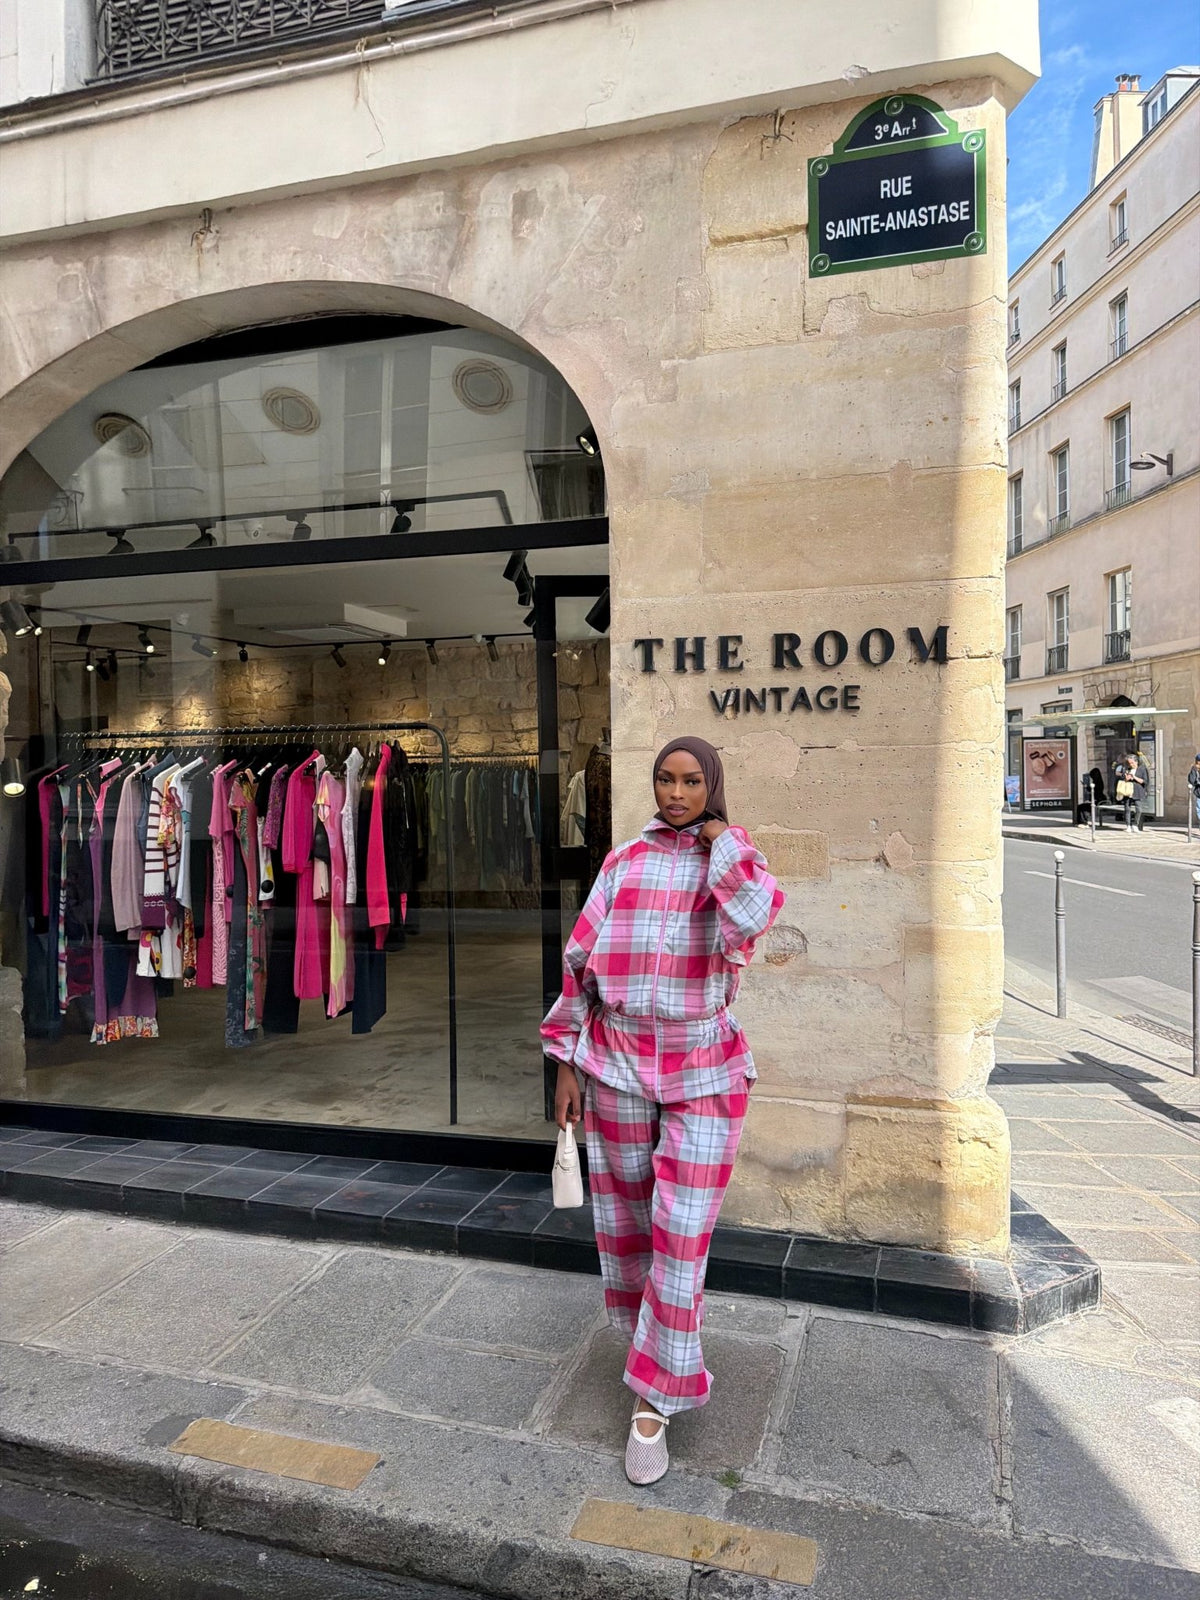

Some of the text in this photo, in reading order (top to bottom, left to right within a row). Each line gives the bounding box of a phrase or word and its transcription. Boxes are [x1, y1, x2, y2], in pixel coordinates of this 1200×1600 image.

[880, 175, 912, 199] RUE
[825, 200, 970, 241] SAINTE-ANASTASE
[633, 625, 950, 673] THE ROOM
[710, 684, 861, 713] VINTAGE
